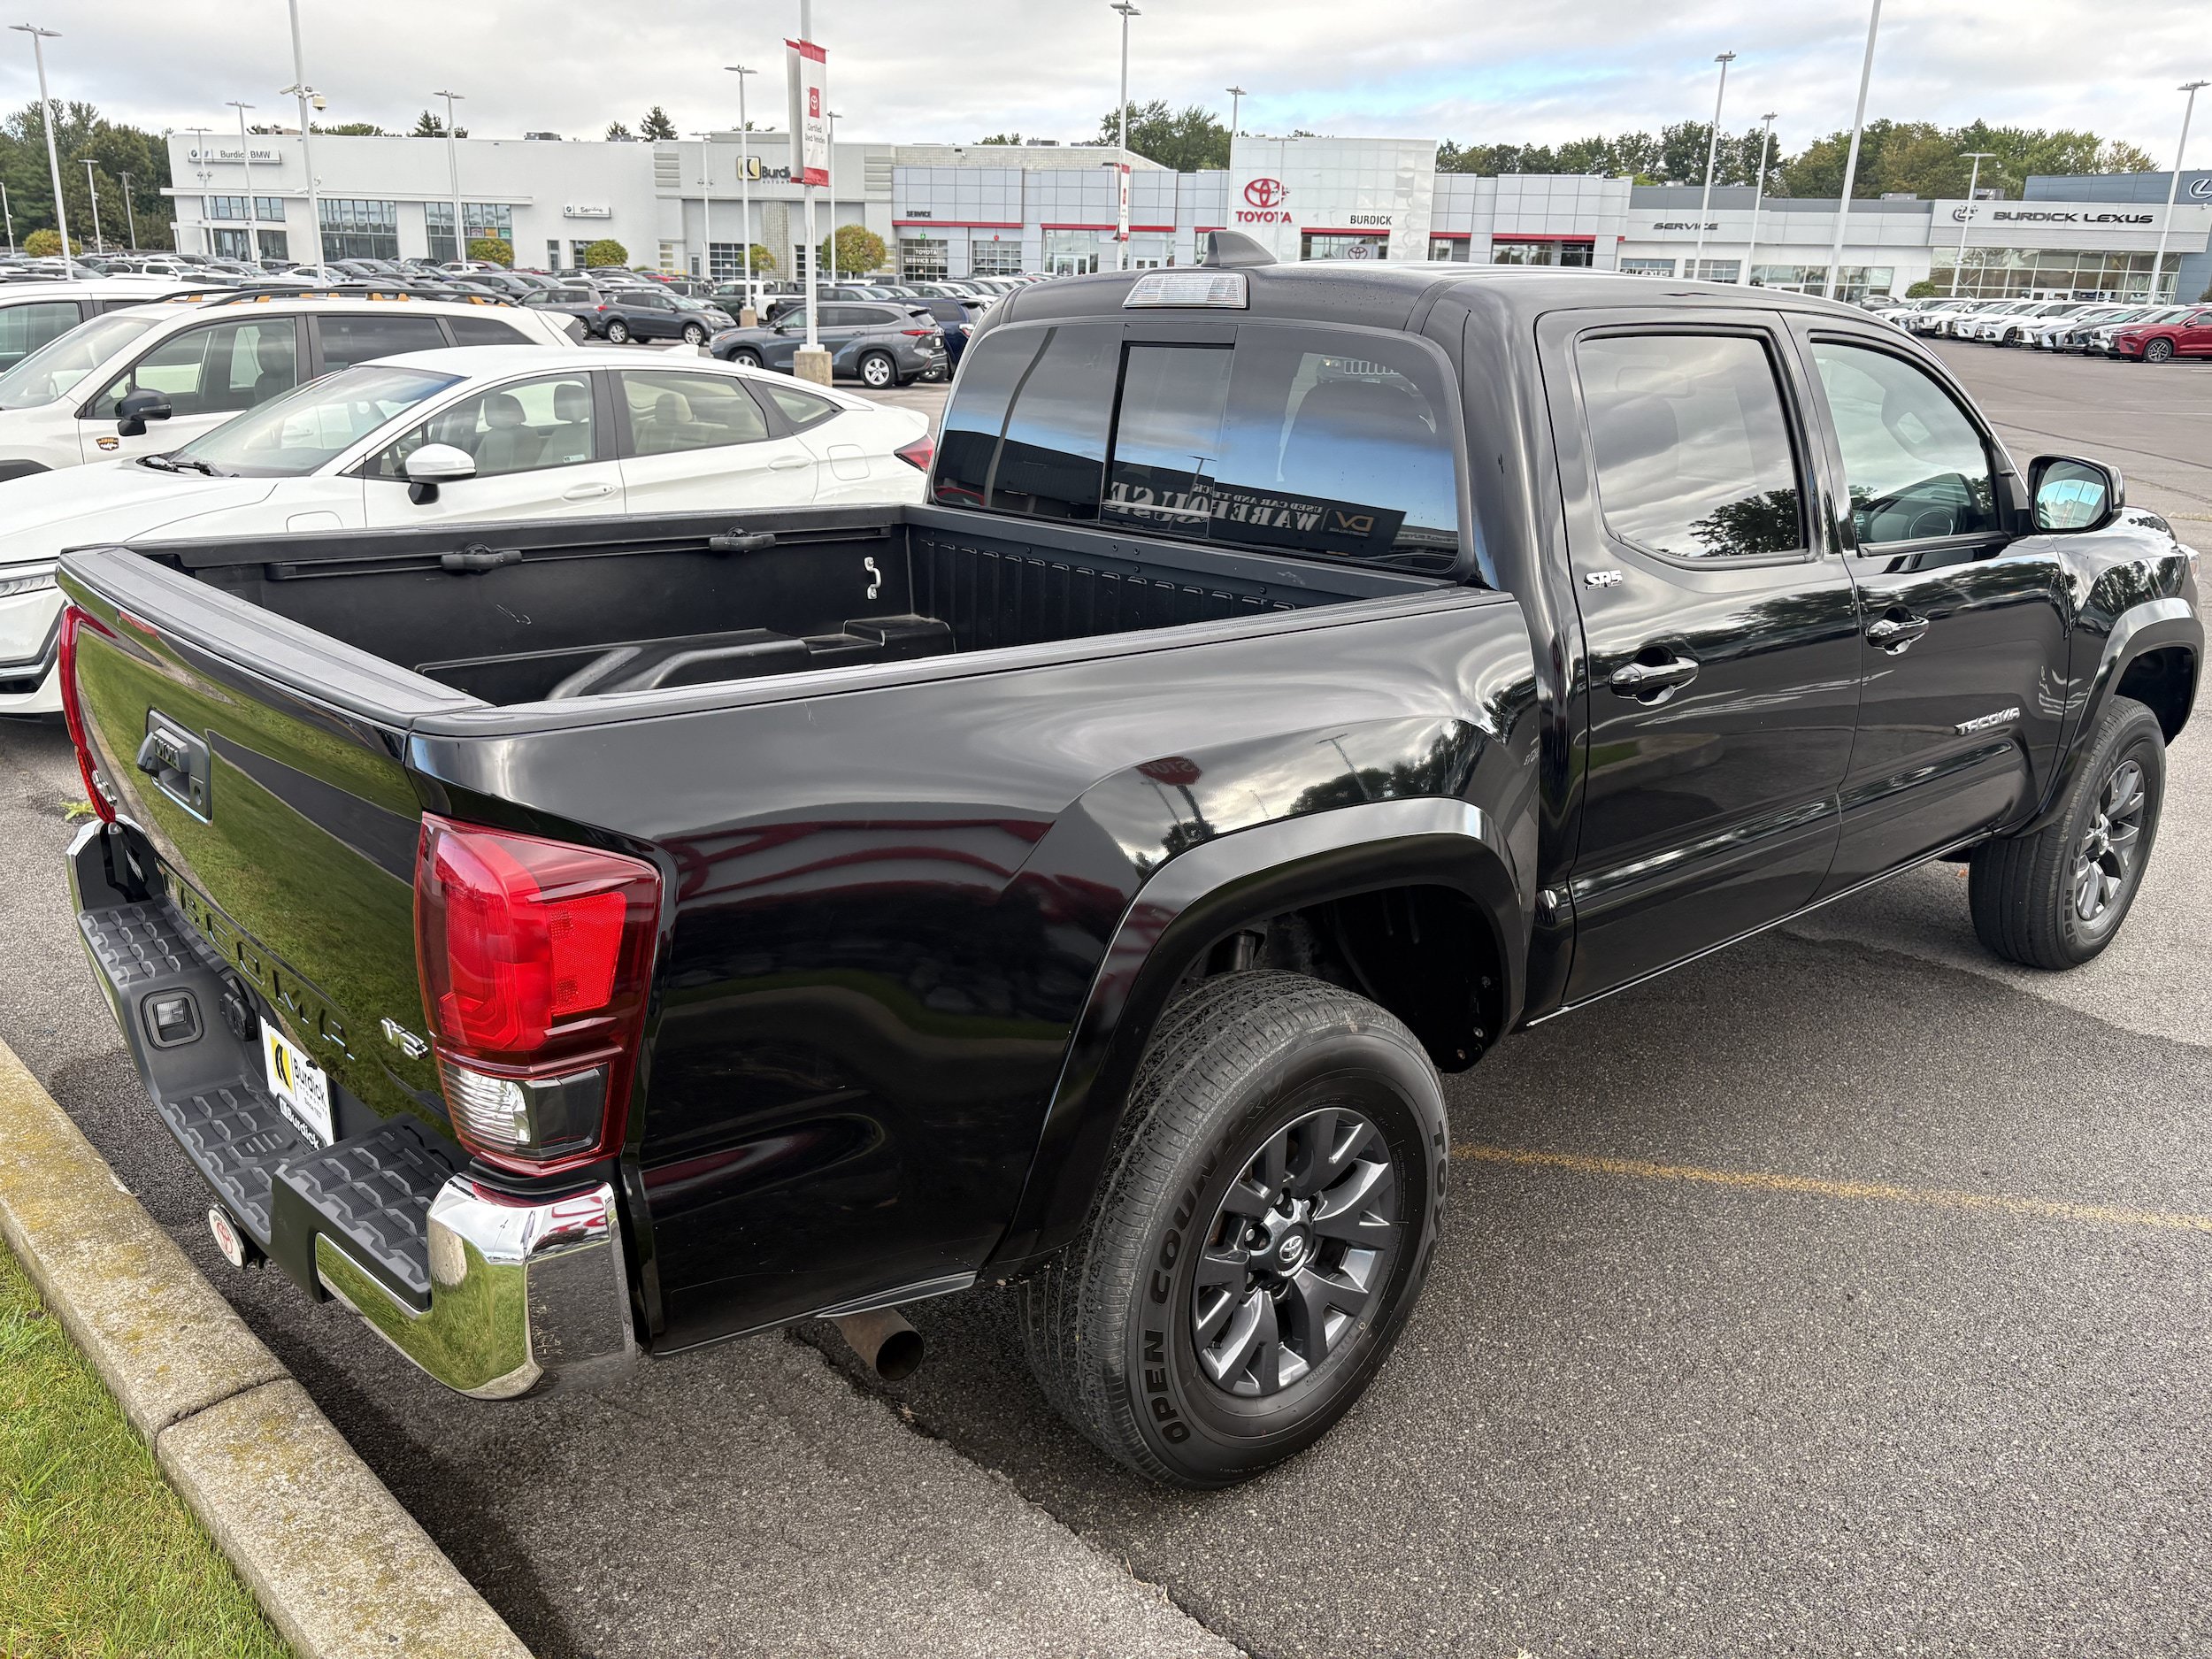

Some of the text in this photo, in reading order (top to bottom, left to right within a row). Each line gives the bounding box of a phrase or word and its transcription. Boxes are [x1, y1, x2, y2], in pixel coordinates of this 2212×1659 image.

[219, 150, 271, 159] Burdic BMW
[762, 165, 791, 179] Burdi
[1235, 211, 1293, 224] TOYOTA
[1350, 214, 1393, 226] BURDICK
[1993, 211, 2154, 224] BURDICK LEXUS
[1584, 570, 1623, 590] SR5
[1954, 707, 2020, 736] TACOMA
[380, 1017, 429, 1061] V6
[293, 1056, 327, 1109] Burdick
[286, 1104, 320, 1151] Burdick
[1151, 1068, 1288, 1306] COUNTRY
[1420, 1119, 1447, 1281] TOYO
[1144, 1328, 1192, 1445] OPEN
